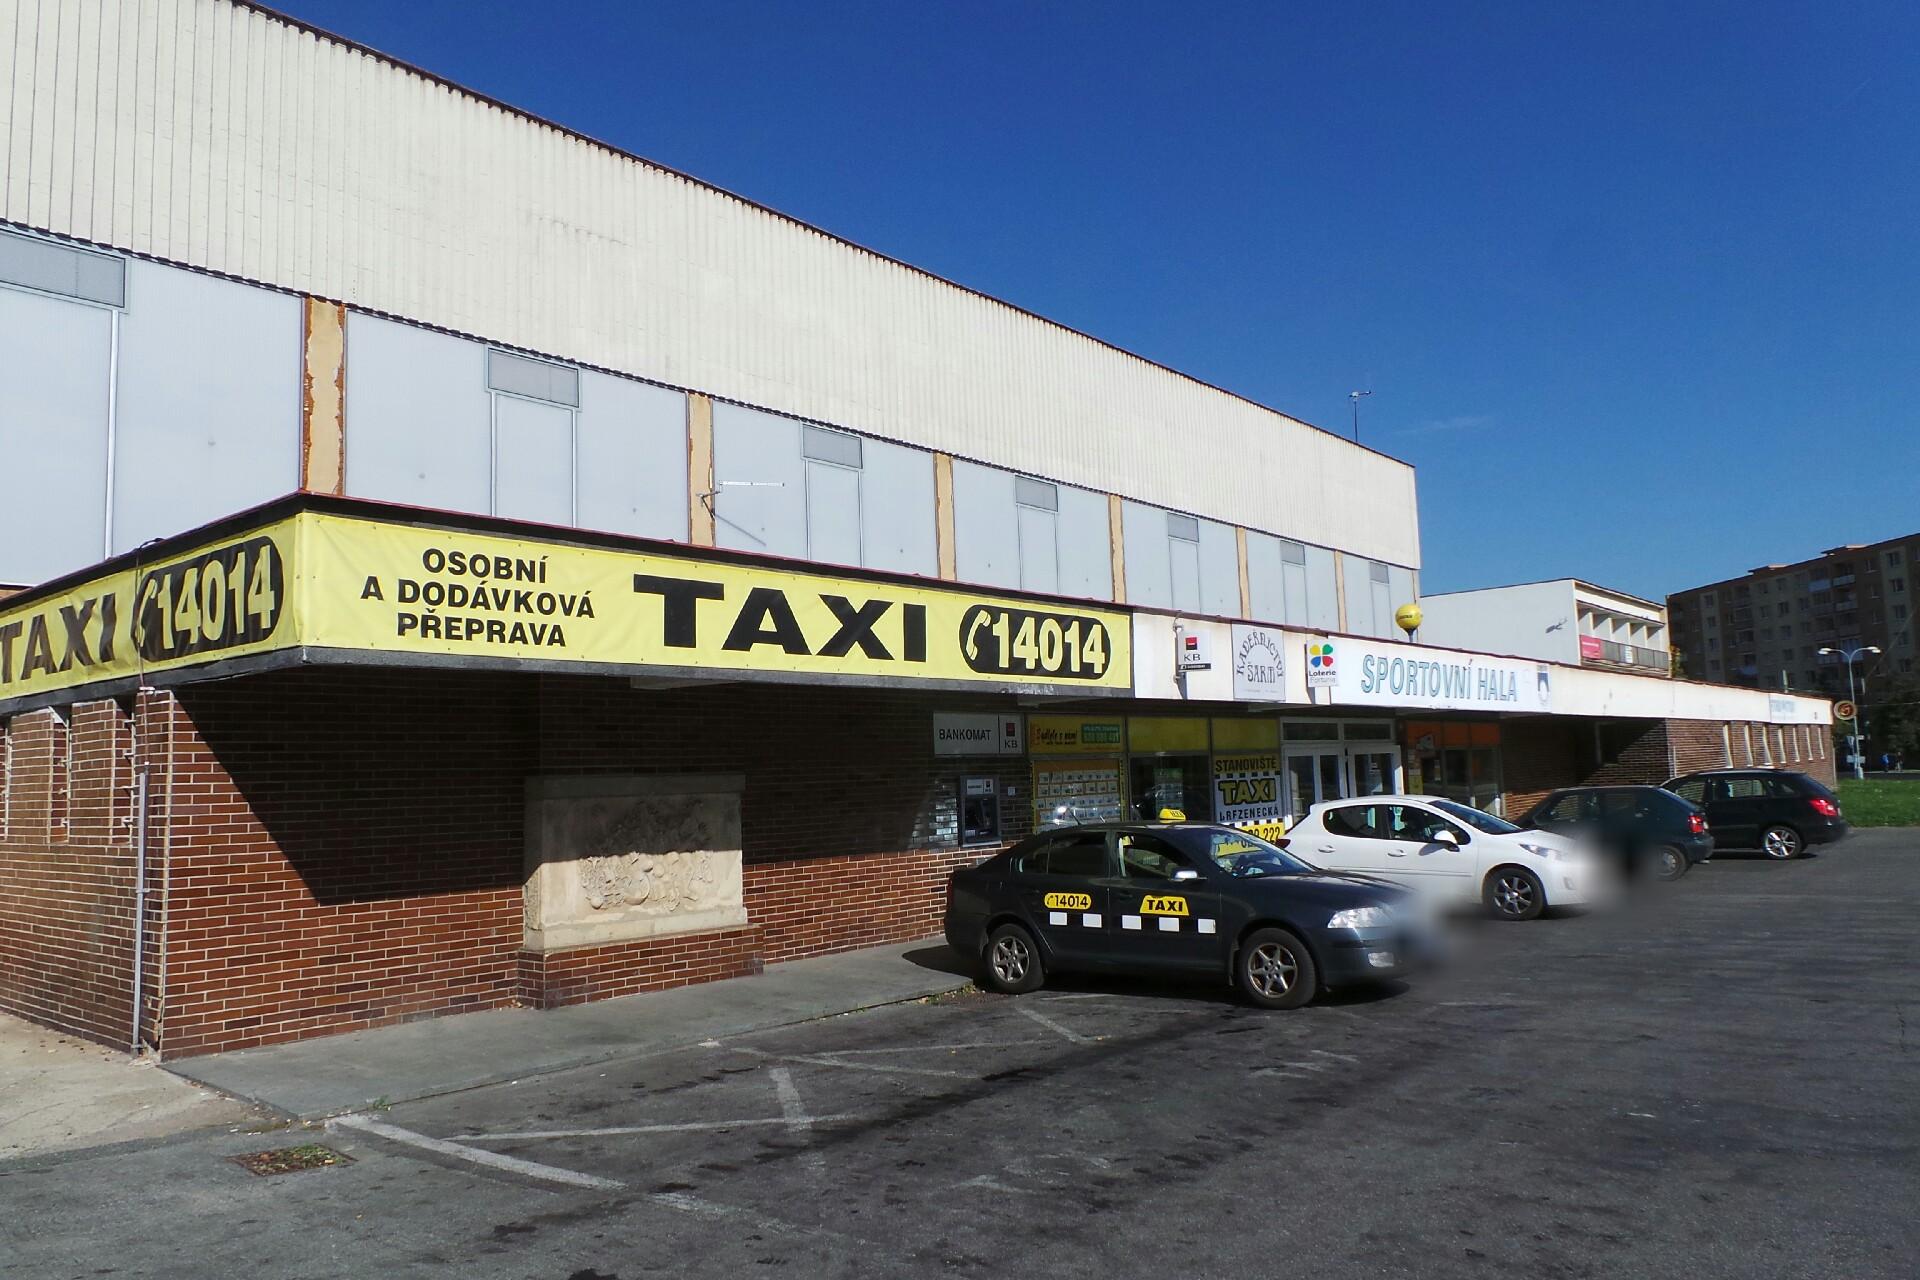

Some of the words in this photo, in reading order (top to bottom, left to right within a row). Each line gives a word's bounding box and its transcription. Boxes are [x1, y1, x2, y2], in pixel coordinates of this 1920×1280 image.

[422, 547, 549, 584] OSOBNÍ
[157, 544, 276, 650] 14014
[360, 575, 385, 601] A
[397, 578, 595, 619] DODÁVKOVÁ
[397, 608, 567, 648] PŘEPRAVA
[633, 574, 927, 663] TAXI
[0, 592, 117, 684] TAXI
[992, 612, 1106, 675] 14014
[1183, 653, 1201, 662] KB
[1361, 654, 1473, 700] SPORTOVNÍ
[1477, 667, 1518, 703] HALA
[938, 728, 992, 742] BANKOMAT
[1004, 739, 1018, 749] KB
[1218, 778, 1277, 806] TAXI
[1055, 894, 1088, 908] 14014
[1146, 899, 1183, 912] TAXI
